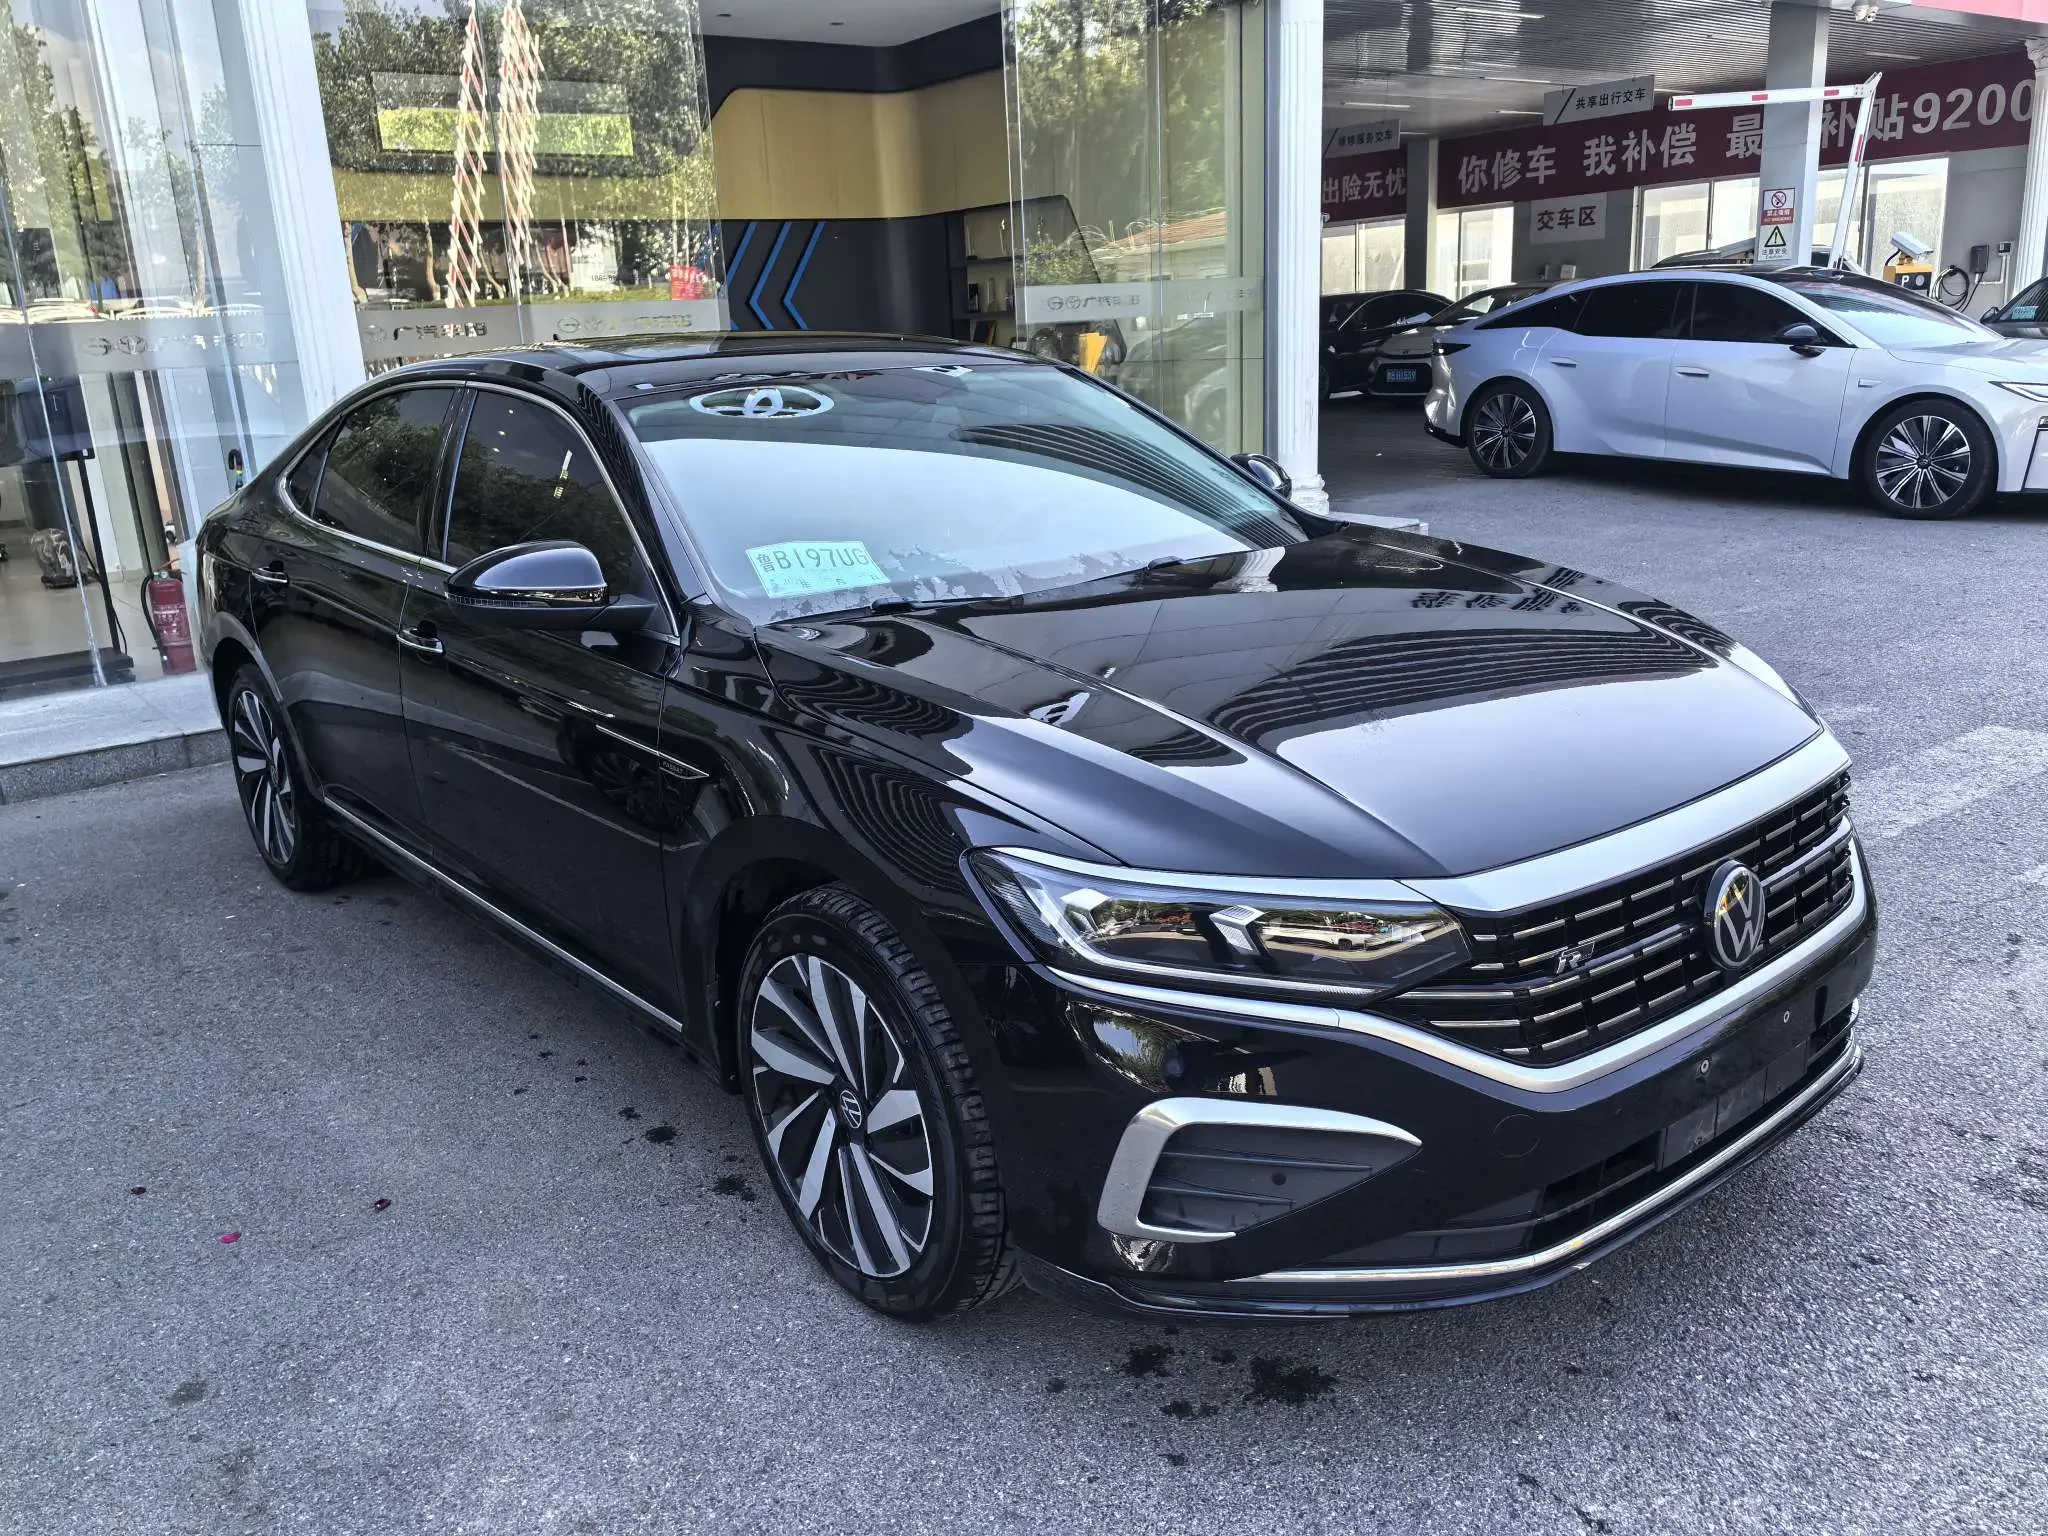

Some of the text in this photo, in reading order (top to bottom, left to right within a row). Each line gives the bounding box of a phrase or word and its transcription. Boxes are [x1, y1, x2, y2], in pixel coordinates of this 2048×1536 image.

[1575, 87, 1647, 110] 共享出行交车
[1322, 79, 2034, 204] 出险无忧 你修车 我补偿 最补贴9200
[1537, 205, 1597, 231] 交车区
